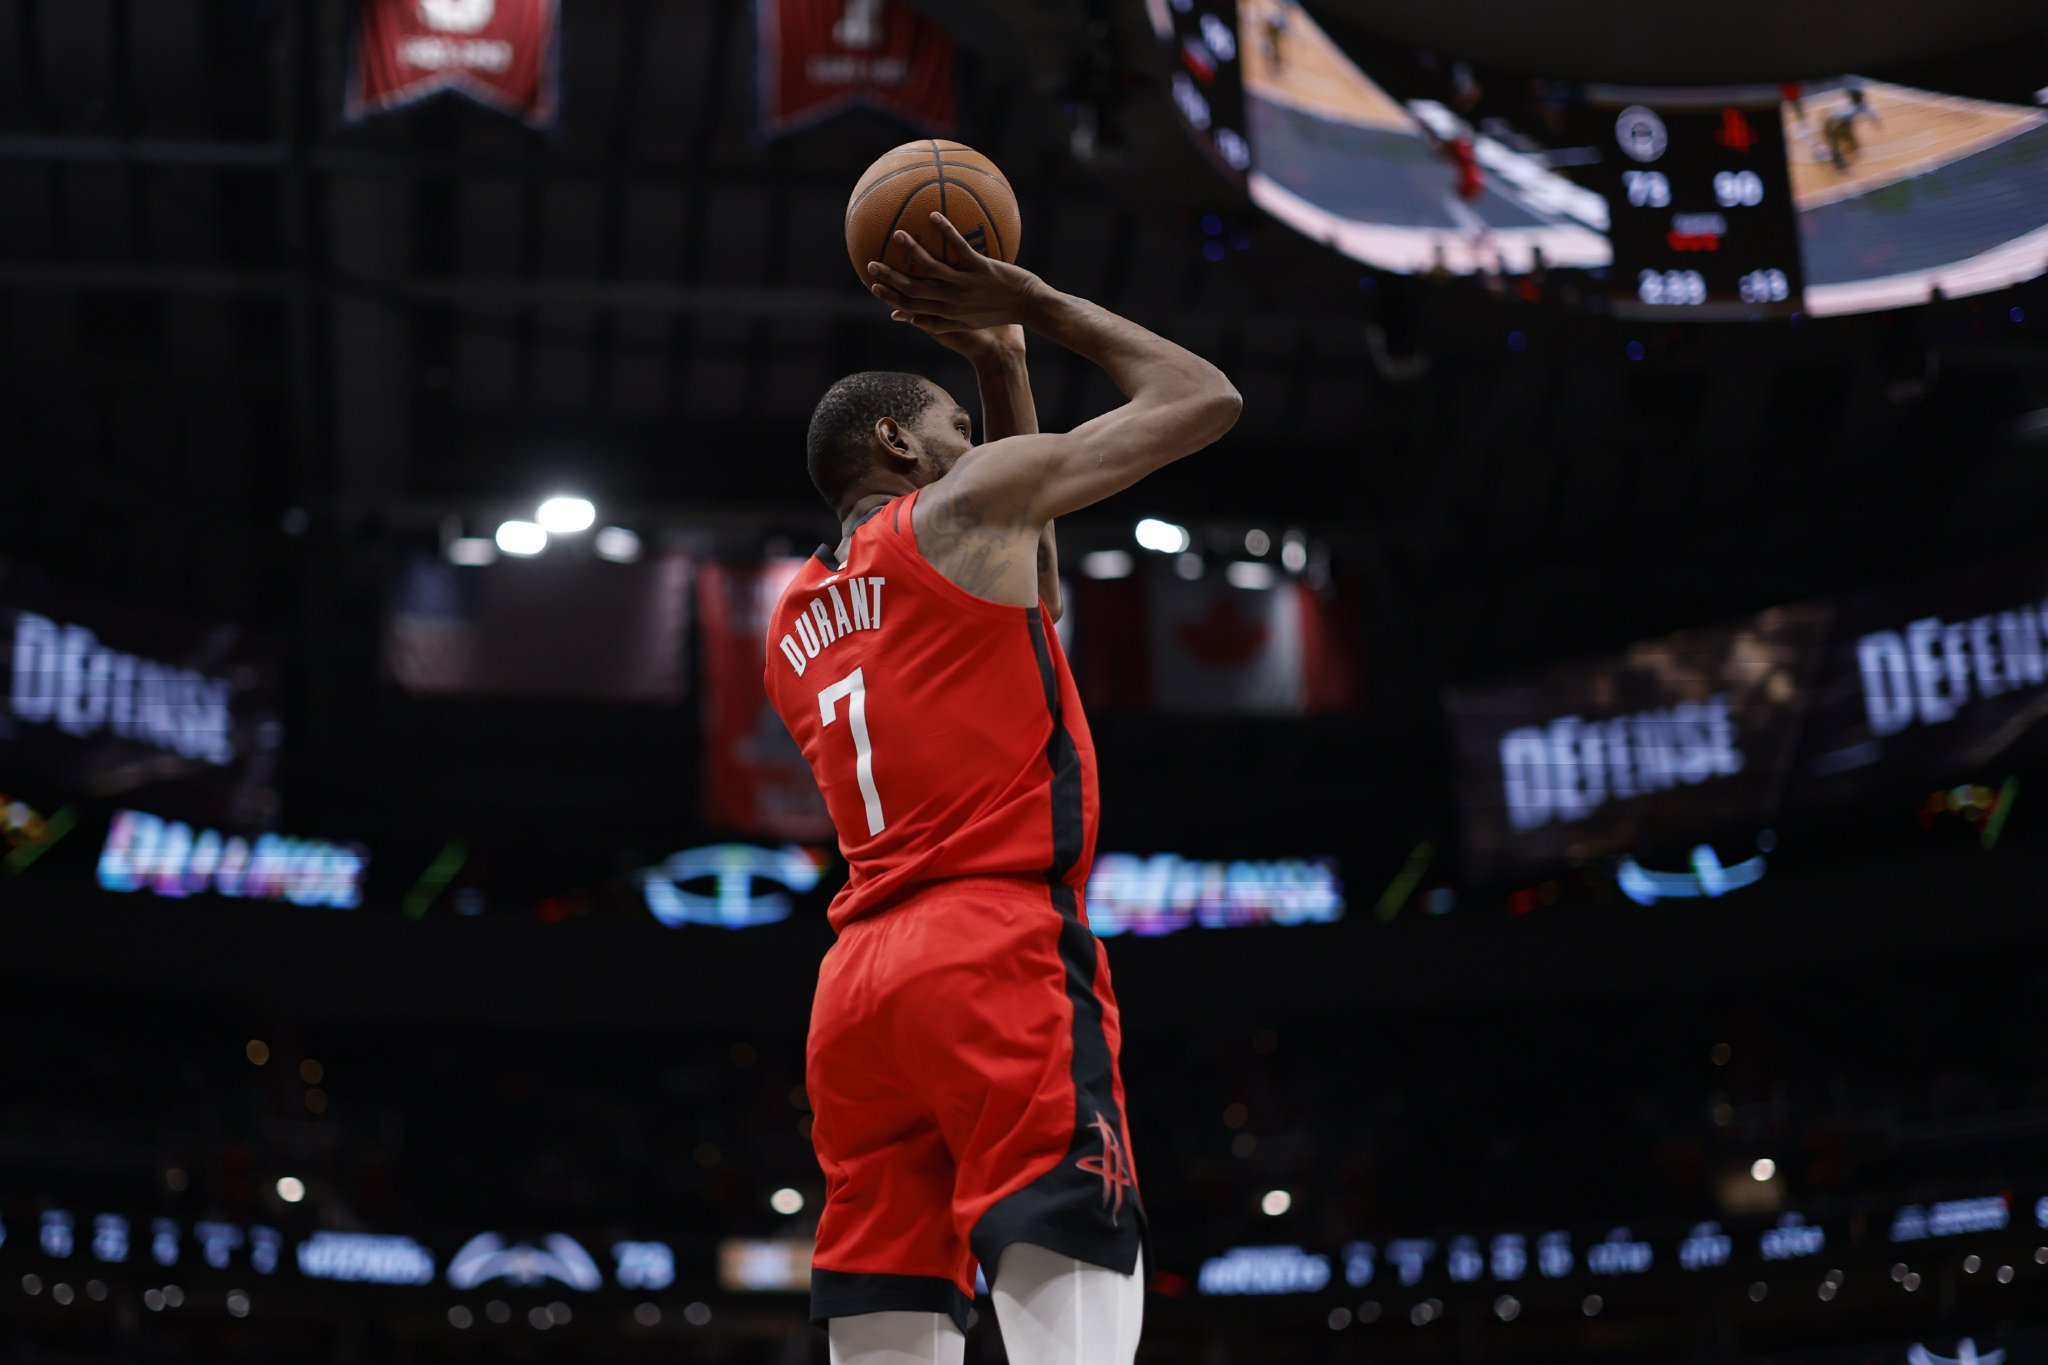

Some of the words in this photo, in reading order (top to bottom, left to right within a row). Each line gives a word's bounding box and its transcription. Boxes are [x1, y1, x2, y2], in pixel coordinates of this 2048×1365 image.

[779, 577, 885, 697] DURANT
[818, 667, 885, 837] 7
[1500, 696, 1745, 833] DEFENSE
